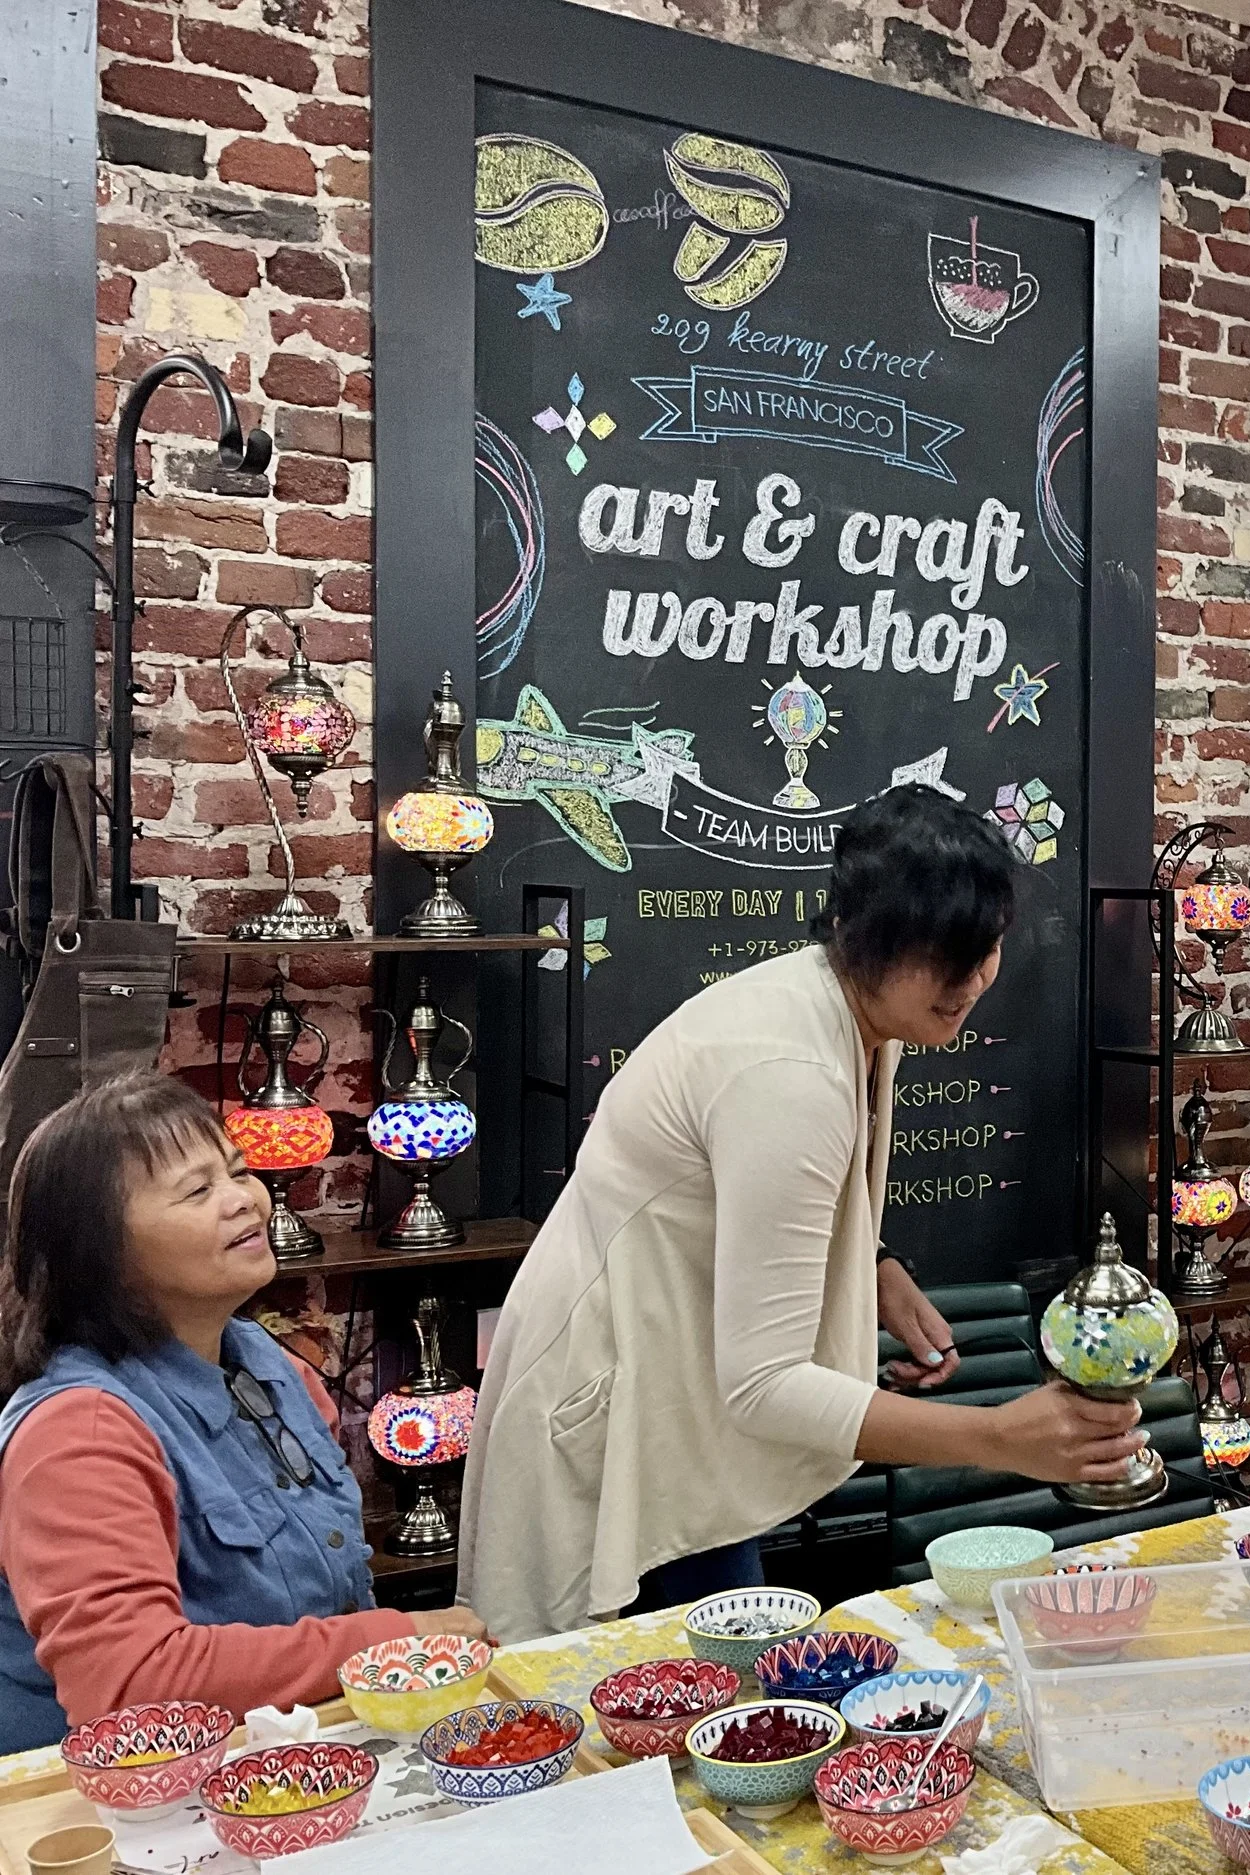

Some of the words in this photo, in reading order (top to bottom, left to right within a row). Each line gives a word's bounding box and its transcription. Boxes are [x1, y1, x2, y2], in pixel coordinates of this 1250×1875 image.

[651, 313, 710, 354] 209
[728, 310, 829, 381] kearny
[839, 339, 935, 380] street
[703, 387, 752, 417] SAN
[757, 390, 894, 438] FRANCISCO
[578, 478, 726, 561] art
[742, 472, 816, 568] &
[837, 497, 1030, 610] craft
[602, 579, 1008, 702] workshop
[692, 804, 769, 848] TEAM
[638, 889, 724, 919] EVERY
[731, 888, 783, 917] DAY
[707, 940, 820, 958] +1-973-97
[894, 1079, 981, 1107] KSHOP
[893, 1124, 997, 1156] RKSHOP
[887, 1173, 993, 1206] RKSHOP
